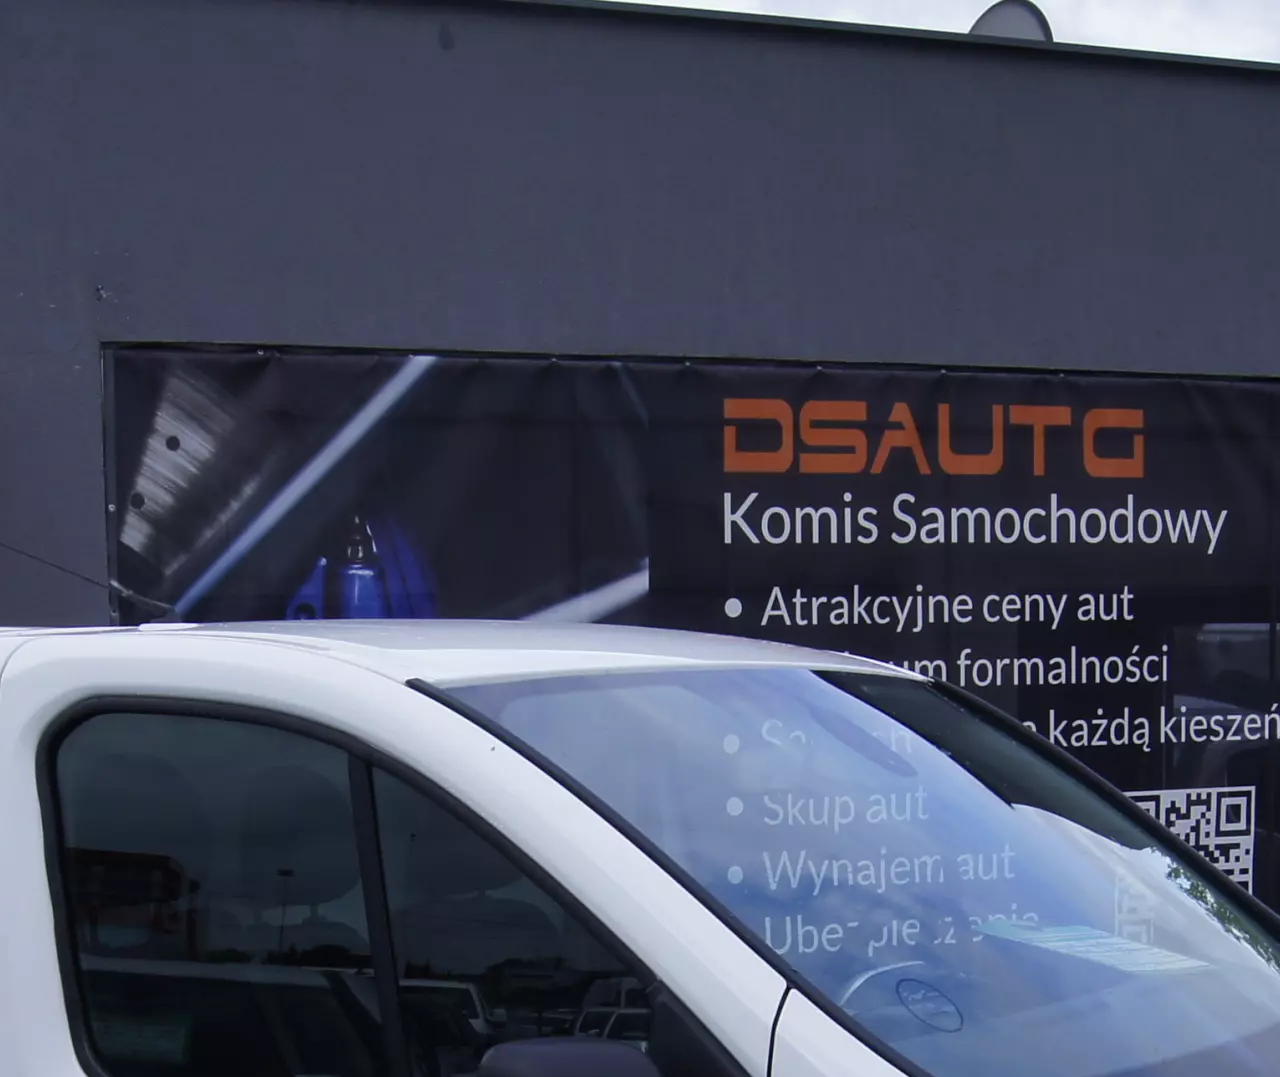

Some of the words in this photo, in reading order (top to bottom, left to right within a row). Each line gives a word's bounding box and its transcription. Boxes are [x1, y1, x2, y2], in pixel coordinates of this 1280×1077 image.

[723, 492, 878, 545] Komis
[891, 493, 1227, 554] Samochodowy
[761, 585, 973, 632] Atrakcyjne
[983, 594, 1067, 630] ceny
[1077, 586, 1134, 621] aut
[957, 645, 1168, 686] formalności
[1049, 705, 1151, 752] każdą
[763, 793, 855, 833] Skup
[866, 785, 929, 823] aut
[763, 846, 944, 895] Wynajem
[957, 844, 1016, 879] aut
